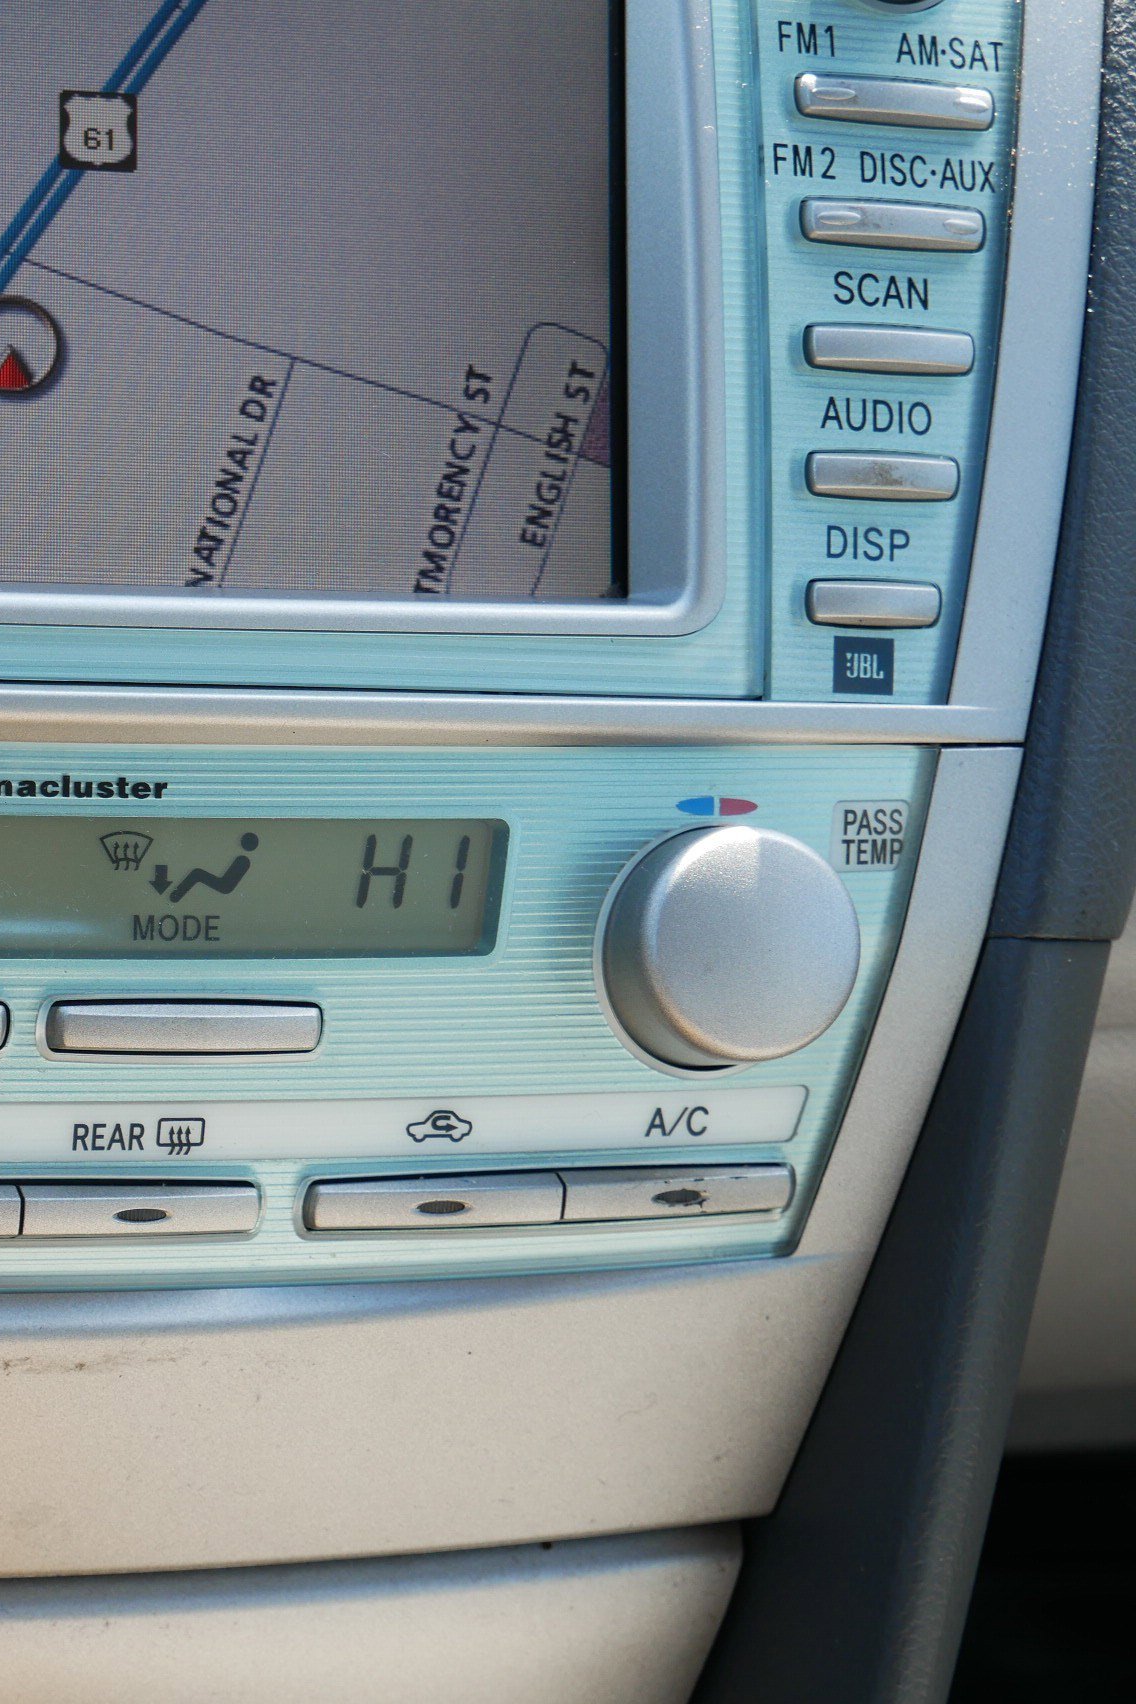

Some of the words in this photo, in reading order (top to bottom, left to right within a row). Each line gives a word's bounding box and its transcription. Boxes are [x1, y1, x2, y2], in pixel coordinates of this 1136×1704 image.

[777, 21, 837, 57] FM1
[82, 126, 116, 152] 61
[773, 143, 836, 180] FM2
[832, 271, 930, 310] SCAN
[239, 374, 277, 424] DR
[465, 364, 492, 405] ST
[821, 397, 932, 436] AUDIO
[520, 411, 579, 548] ENGLISH
[564, 360, 596, 404] ST
[826, 525, 910, 562] DISP
[845, 655, 885, 681] JBL
[843, 809, 903, 836] PASS
[842, 838, 904, 866] TEMP
[132, 914, 221, 942] MODE
[72, 1123, 144, 1152] REAR
[645, 1107, 708, 1138] A/C
